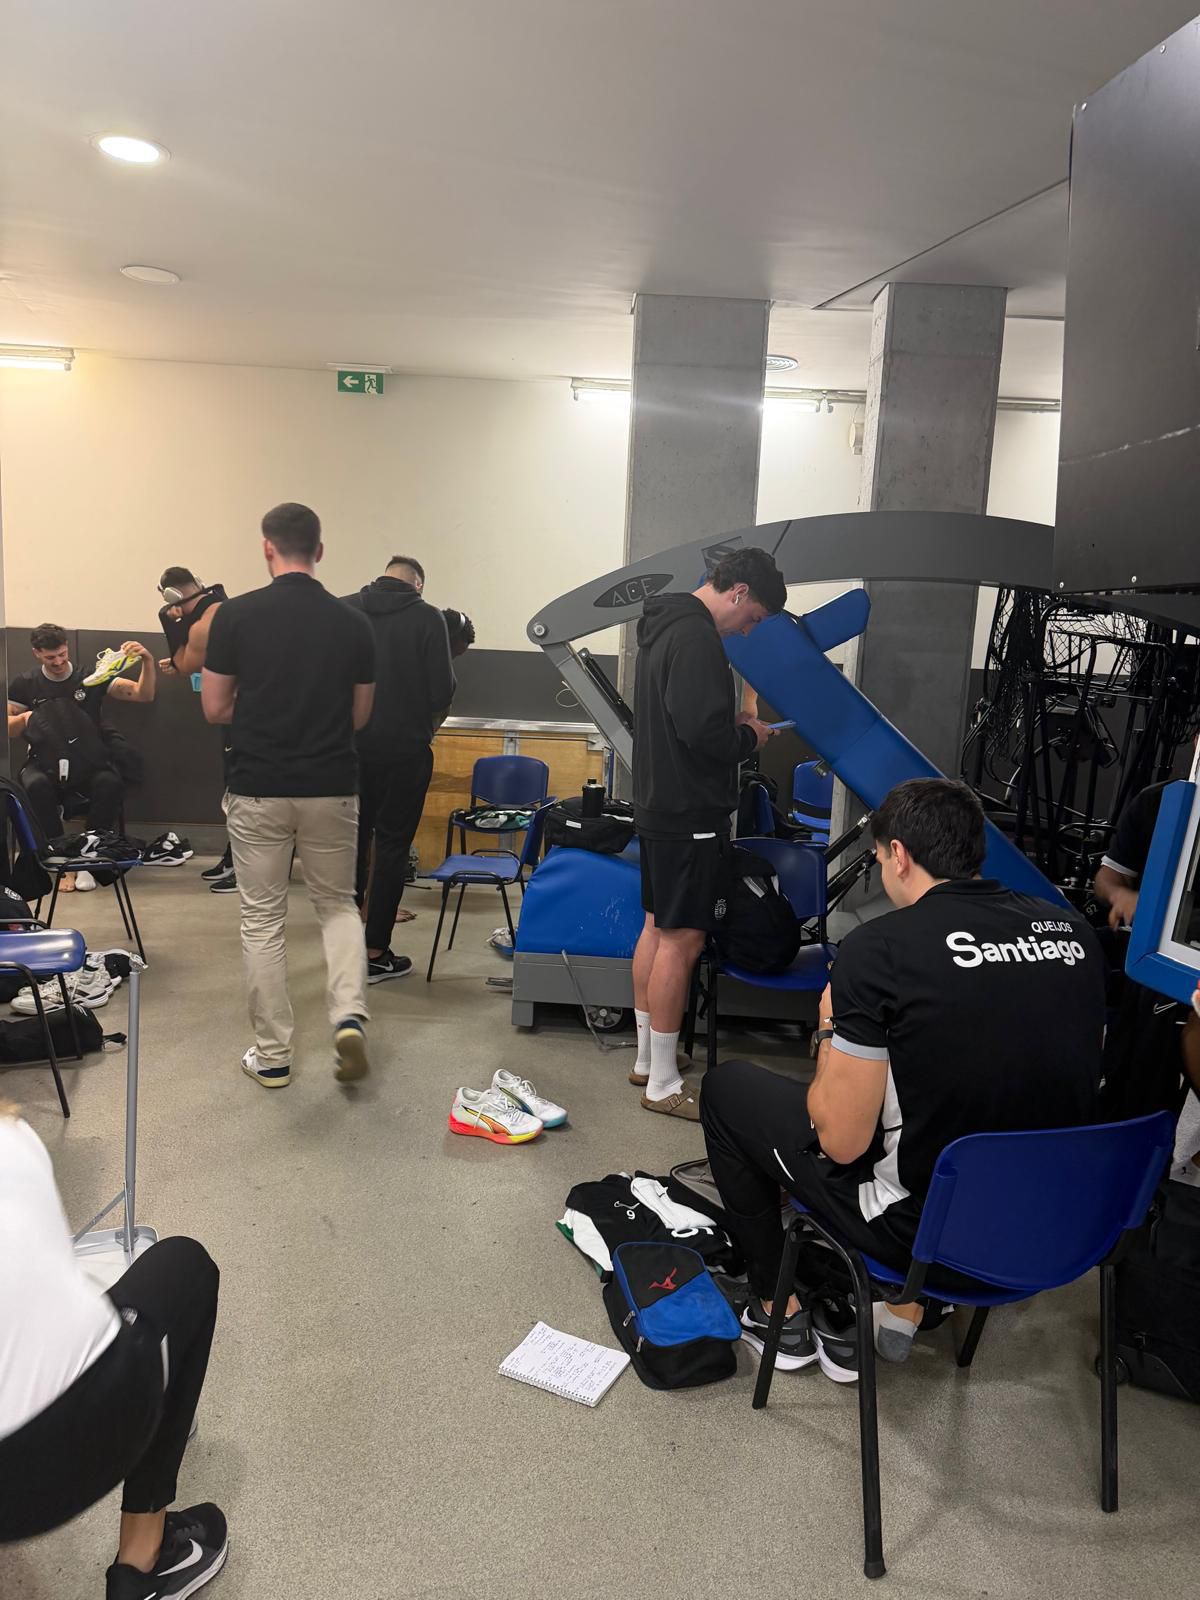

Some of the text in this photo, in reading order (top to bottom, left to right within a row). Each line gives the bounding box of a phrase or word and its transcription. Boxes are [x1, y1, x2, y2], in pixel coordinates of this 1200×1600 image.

[613, 578, 655, 606] ACE
[1031, 921, 1072, 933] QUEIJOS
[945, 931, 1085, 968] Santiago
